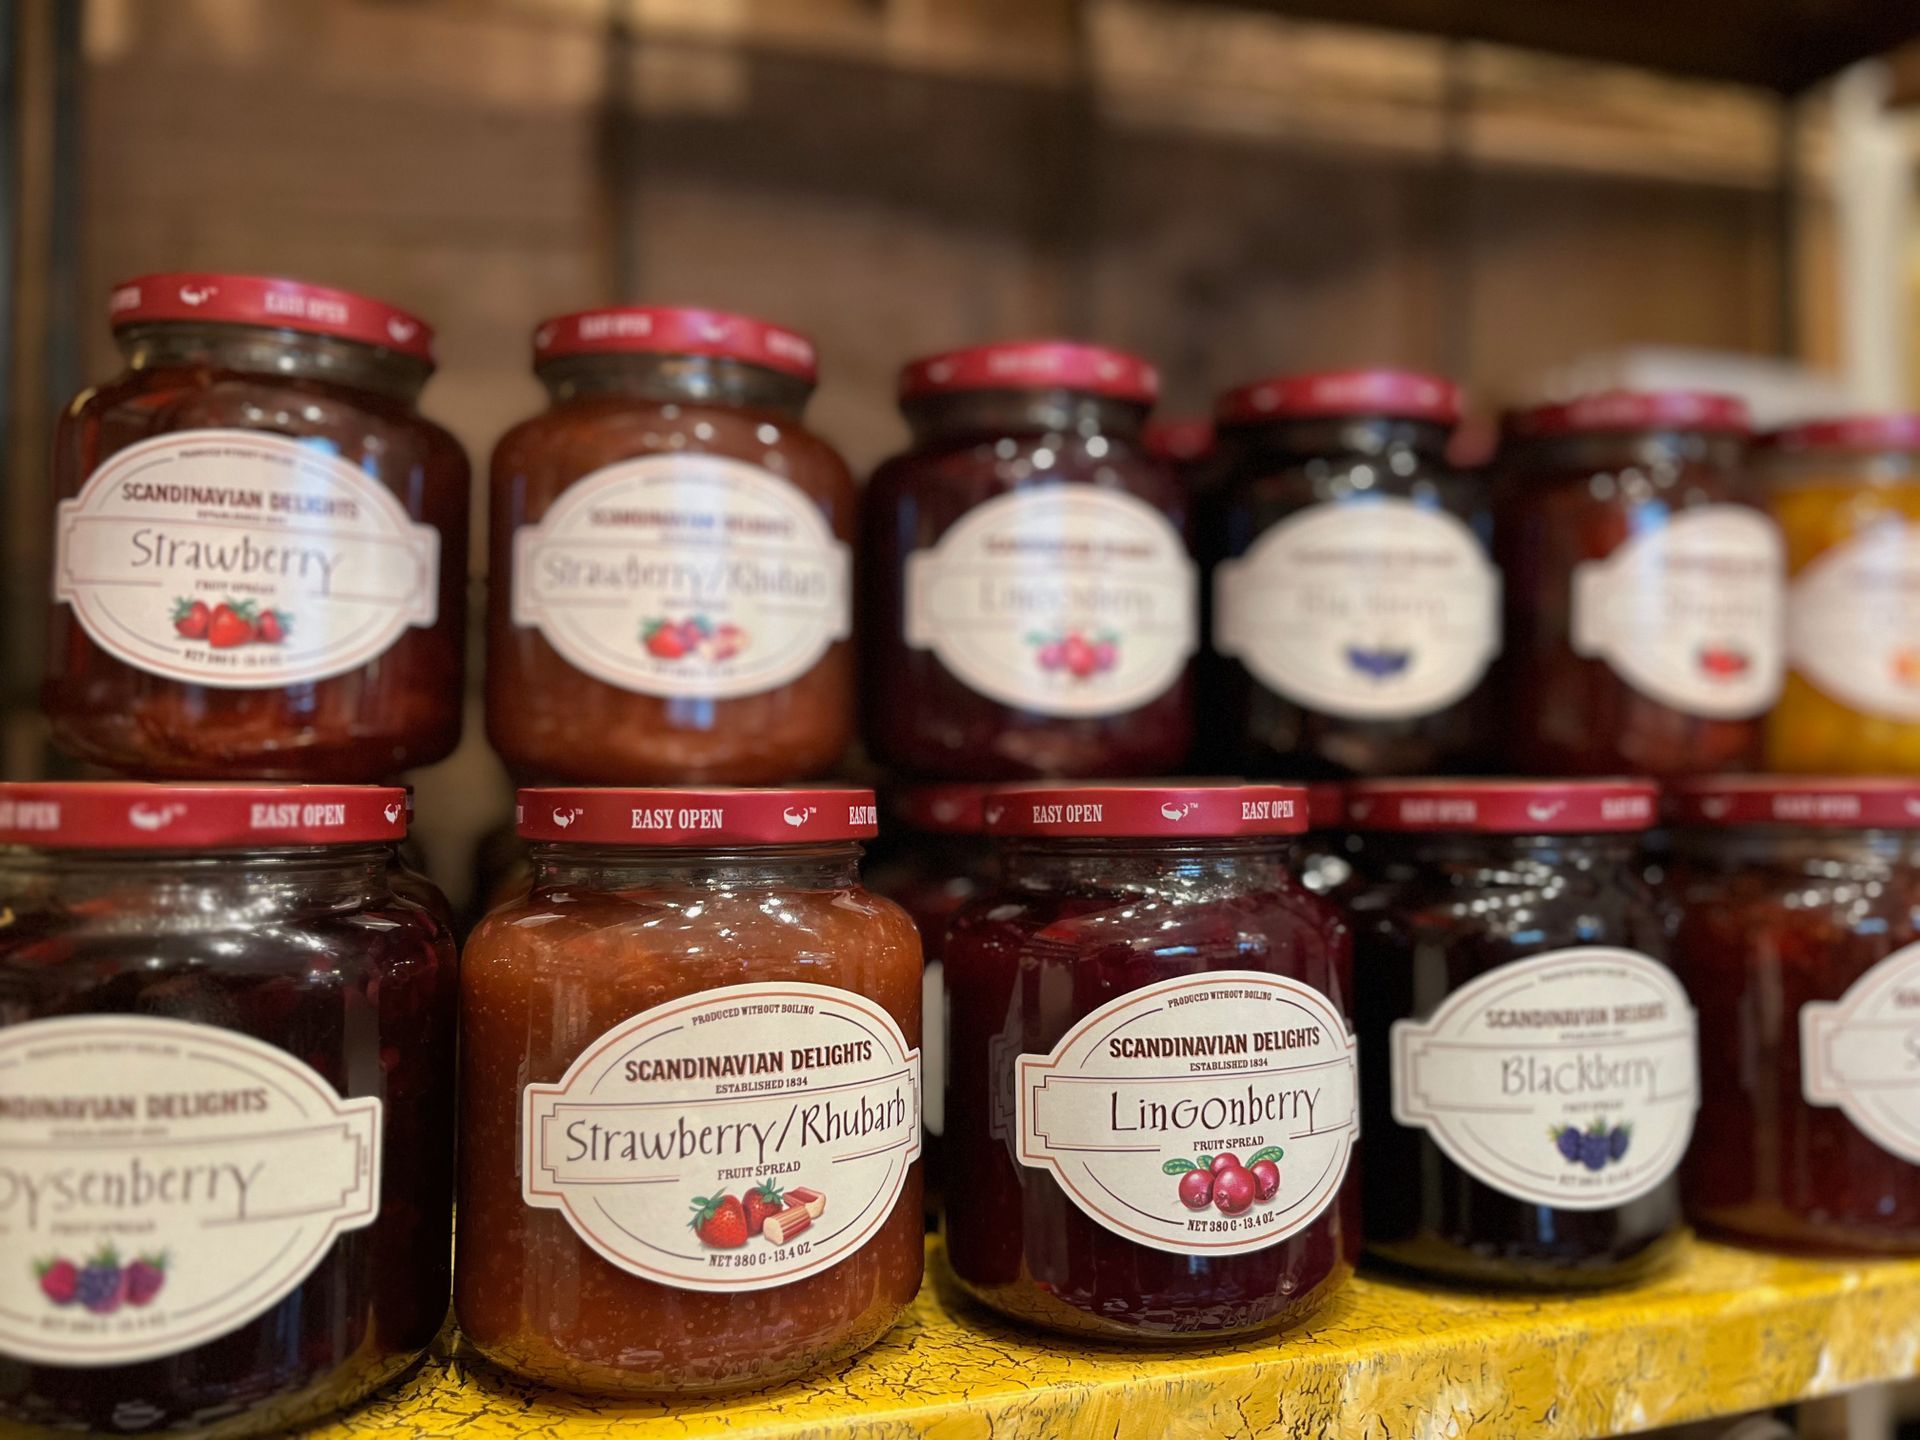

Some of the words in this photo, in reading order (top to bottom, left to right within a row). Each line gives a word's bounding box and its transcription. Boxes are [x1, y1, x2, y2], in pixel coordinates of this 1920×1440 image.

[121, 483, 263, 508] SCANDINAVIAN
[131, 528, 345, 596] Strawberry
[251, 804, 300, 828] EASY
[303, 803, 345, 826] OPEN
[631, 808, 673, 830] EASY
[678, 808, 723, 829] OPEN
[849, 806, 867, 825] EASY
[1033, 805, 1063, 823] EASY
[1066, 804, 1102, 822] OPEN
[1242, 801, 1270, 820] EASY
[1272, 800, 1294, 818] OPEN
[1168, 992, 1209, 1008] PRODUCED
[1210, 990, 1243, 1000] WITHOUT
[1244, 990, 1272, 1000] BOILING
[692, 1008, 739, 1026] PRODUCED
[741, 1004, 780, 1016] WITHOUT
[781, 1004, 815, 1015] BOILING
[1109, 1034, 1249, 1059] SCANDINAVIAN
[1253, 1026, 1320, 1052] DELIGHTS
[625, 1051, 784, 1083] SCANDINAVIAN
[790, 1040, 873, 1071] DELIGHTS
[1190, 1059, 1248, 1071] ESTABLISHED
[1250, 1058, 1268, 1068] 1834
[716, 1079, 784, 1095] ESTABLISHED
[786, 1076, 808, 1088] 1834
[1501, 1052, 1661, 1104] Blackberry
[146, 1087, 268, 1119] DELIGHTS
[1111, 1083, 1321, 1135] Lingonberry
[565, 1086, 906, 1164] Strawberry/Rhubarb
[1193, 1139, 1226, 1152] FRUIT
[1226, 1136, 1264, 1150] SPREAD
[718, 1166, 753, 1180] FRUIT
[755, 1160, 801, 1177] SPREAD
[1187, 1219, 1208, 1232] NET
[1209, 1220, 1229, 1232] 380
[1243, 1215, 1261, 1229] 13.4
[1262, 1210, 1275, 1224] OZ
[709, 1254, 732, 1267] NET
[734, 1254, 756, 1266] 380
[773, 1246, 794, 1262] 13.4
[797, 1241, 812, 1255] OZ
